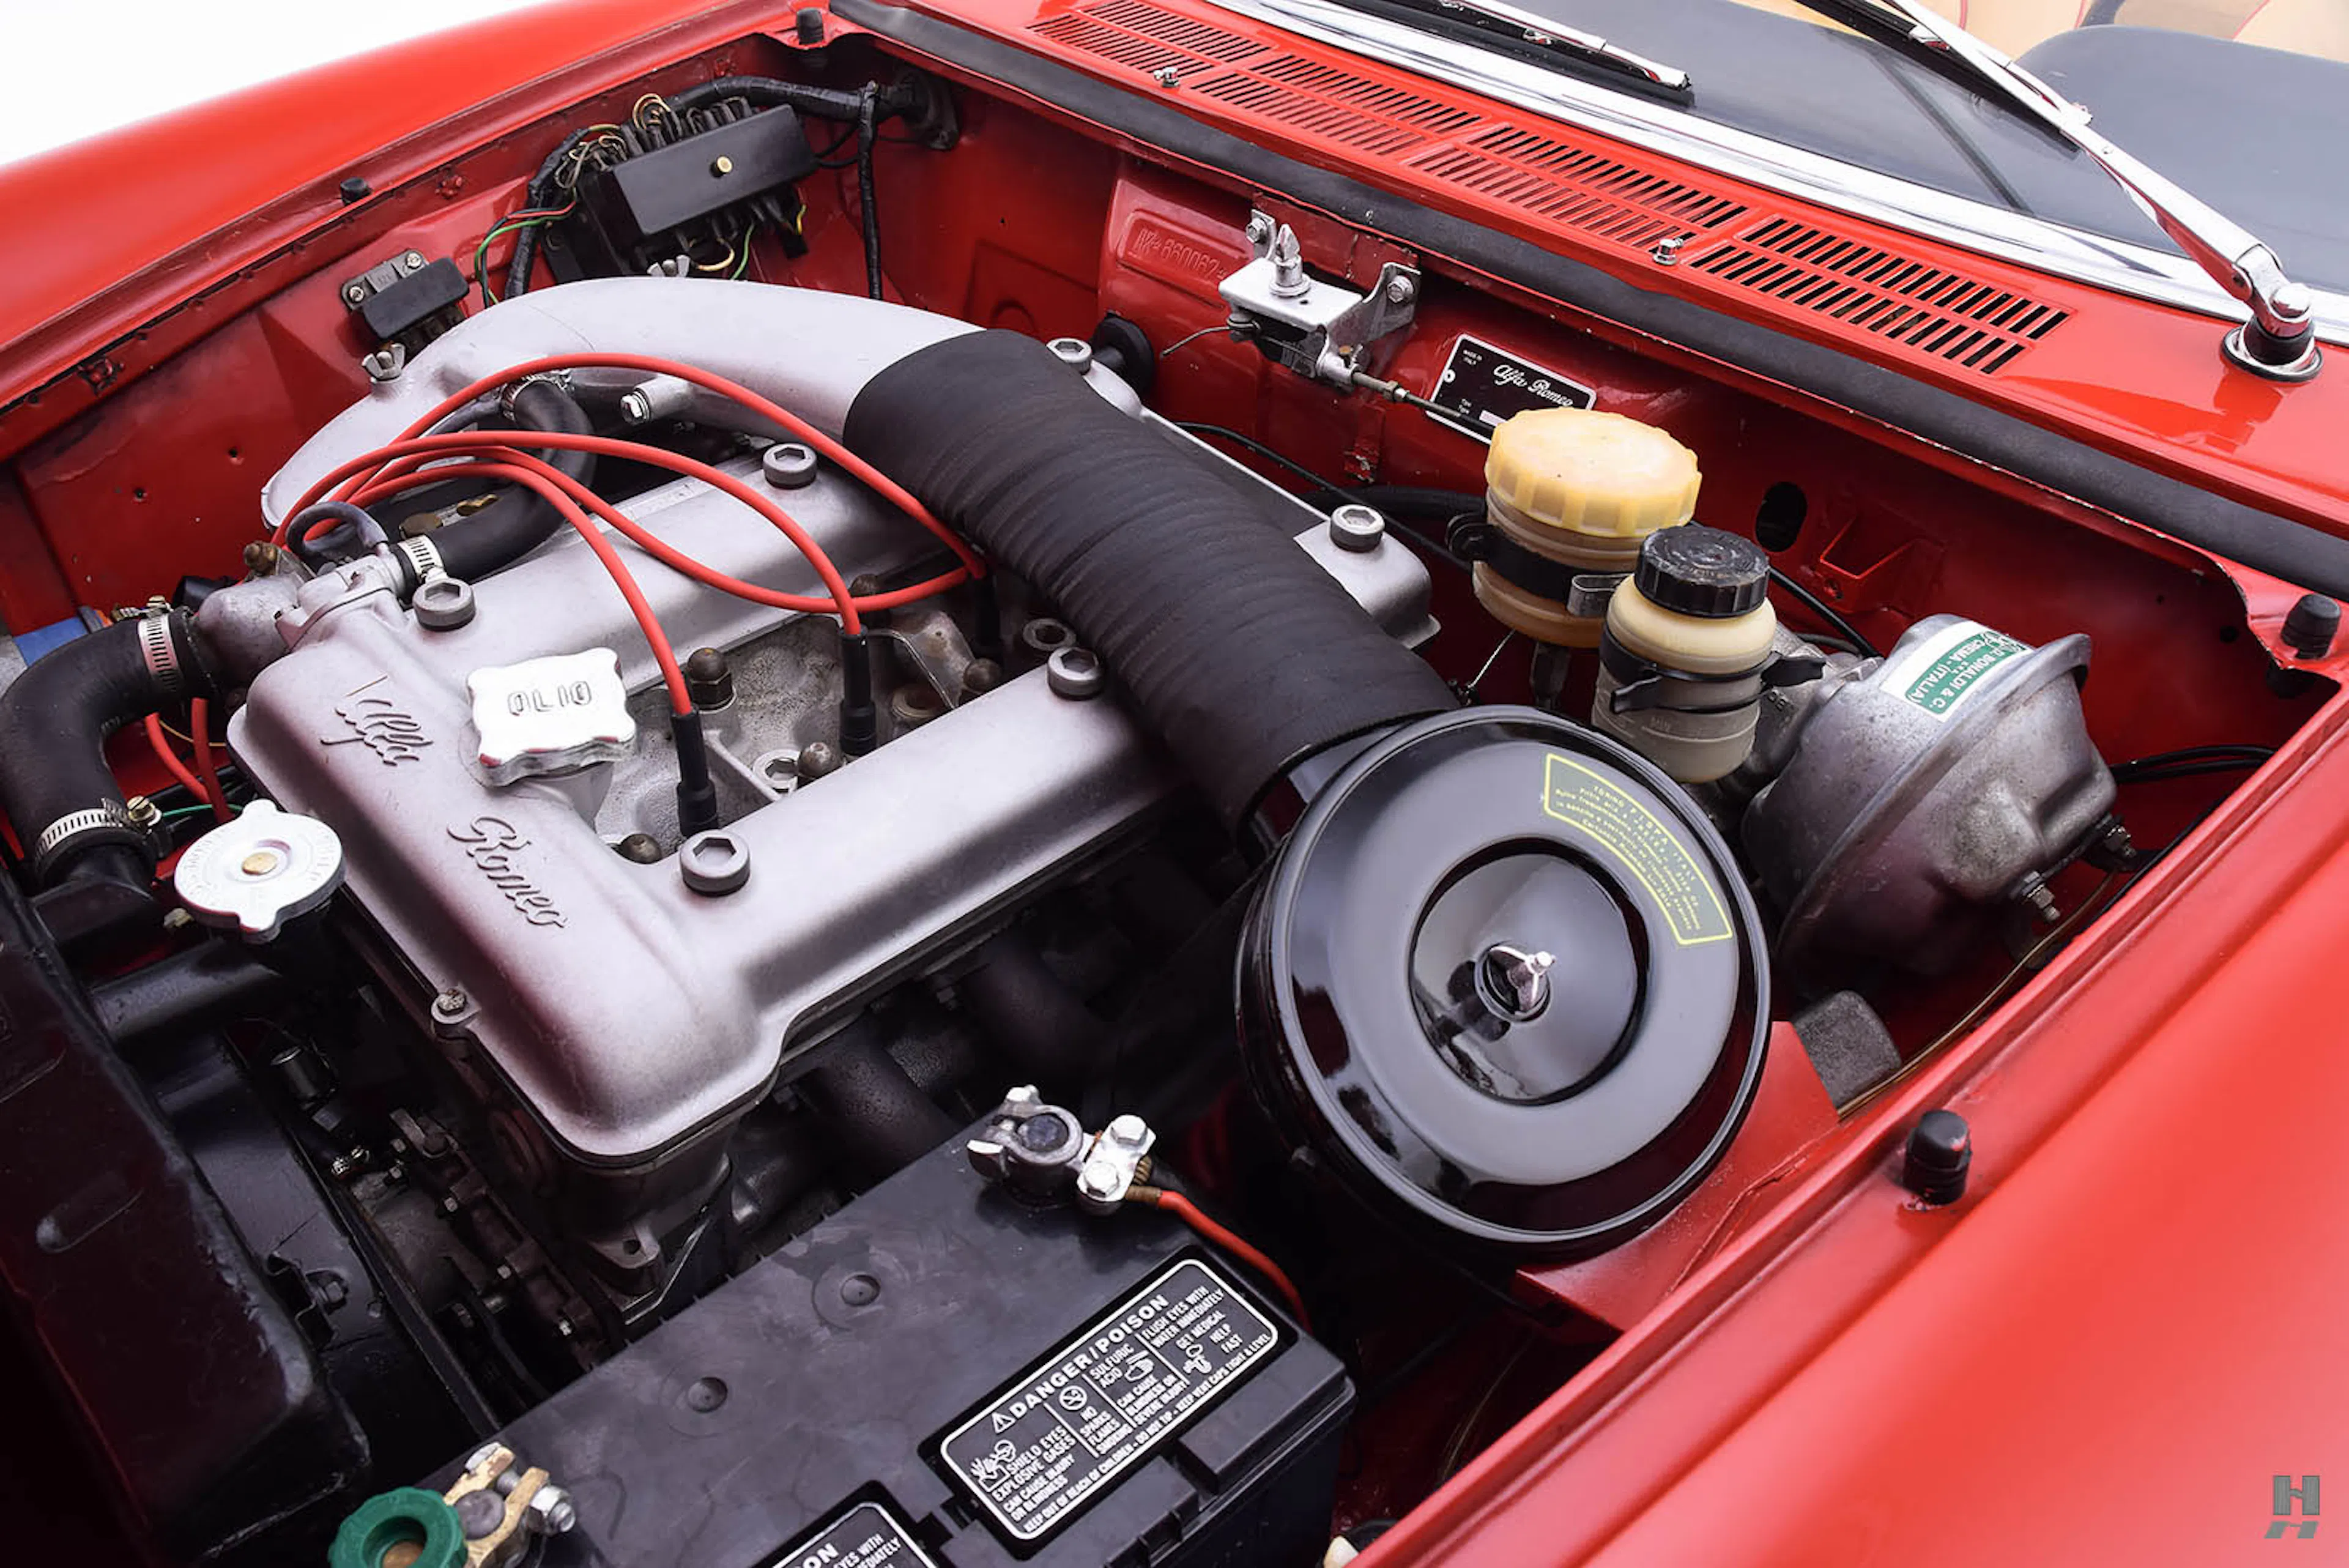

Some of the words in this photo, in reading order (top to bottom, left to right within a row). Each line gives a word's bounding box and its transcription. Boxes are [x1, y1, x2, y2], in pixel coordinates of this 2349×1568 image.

[1493, 365, 1527, 387] Alfa
[1527, 379, 1573, 406] Romeo
[507, 680, 592, 716] OLIO
[447, 816, 569, 929] Romeo
[1141, 1317, 1170, 1340] FLUSH
[1167, 1301, 1189, 1321] EYES
[1186, 1285, 1210, 1306] WITH
[1150, 1325, 1181, 1348] WATER
[1176, 1288, 1224, 1329] IMMEDIATELY
[1176, 1333, 1195, 1350] GET
[1191, 1310, 1226, 1339] MEDICAL
[1209, 1323, 1231, 1344] HELP
[1221, 1333, 1244, 1354] FAST
[1009, 1294, 1169, 1419] DANGER/POISON
[1089, 1343, 1135, 1380] SULFURIC
[1099, 1367, 1123, 1389] ACID
[1080, 1405, 1098, 1422] NO
[1116, 1392, 1137, 1408] CAN
[1080, 1410, 1111, 1438] SPARKS
[1087, 1418, 1121, 1446] FLAMES
[1006, 1445, 1042, 1476] SHIELD
[1040, 1425, 1067, 1449] EYES
[992, 1460, 1045, 1502] EXPLOSIVE
[1042, 1437, 1077, 1463] GASES
[1003, 1495, 1023, 1514] CAN
[1019, 1476, 1048, 1498] CAUSE
[1011, 1507, 1027, 1522] OR
[1023, 1513, 1044, 1532] KEEP
[1042, 1502, 1059, 1518] OUT
[857, 1533, 885, 1556] WITH
